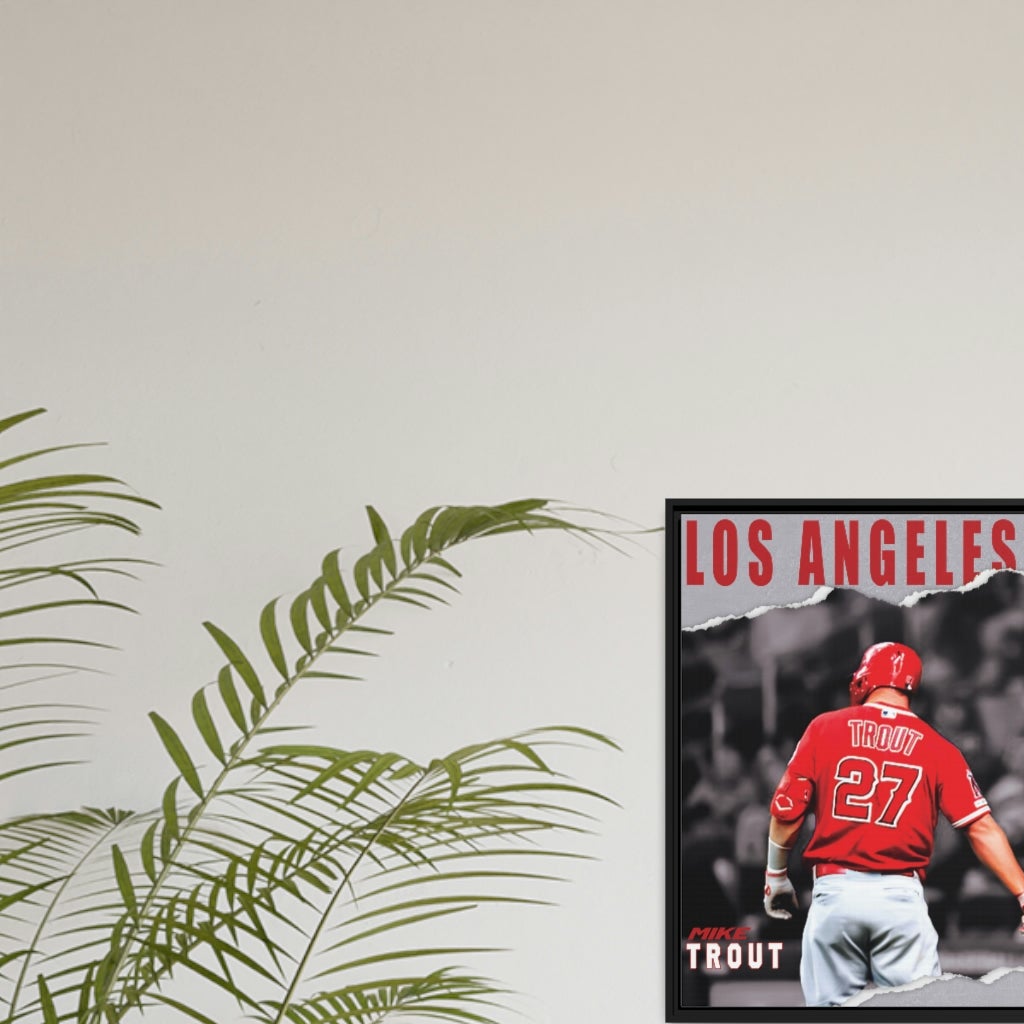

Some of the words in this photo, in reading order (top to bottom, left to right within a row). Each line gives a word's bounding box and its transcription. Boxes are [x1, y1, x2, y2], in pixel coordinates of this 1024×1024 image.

[686, 519, 774, 587] LOS
[798, 519, 1016, 587] ANGELES
[847, 719, 923, 756] TROUT
[832, 756, 923, 828] 27
[687, 926, 752, 940] MIKE
[686, 942, 783, 970] TROUT
